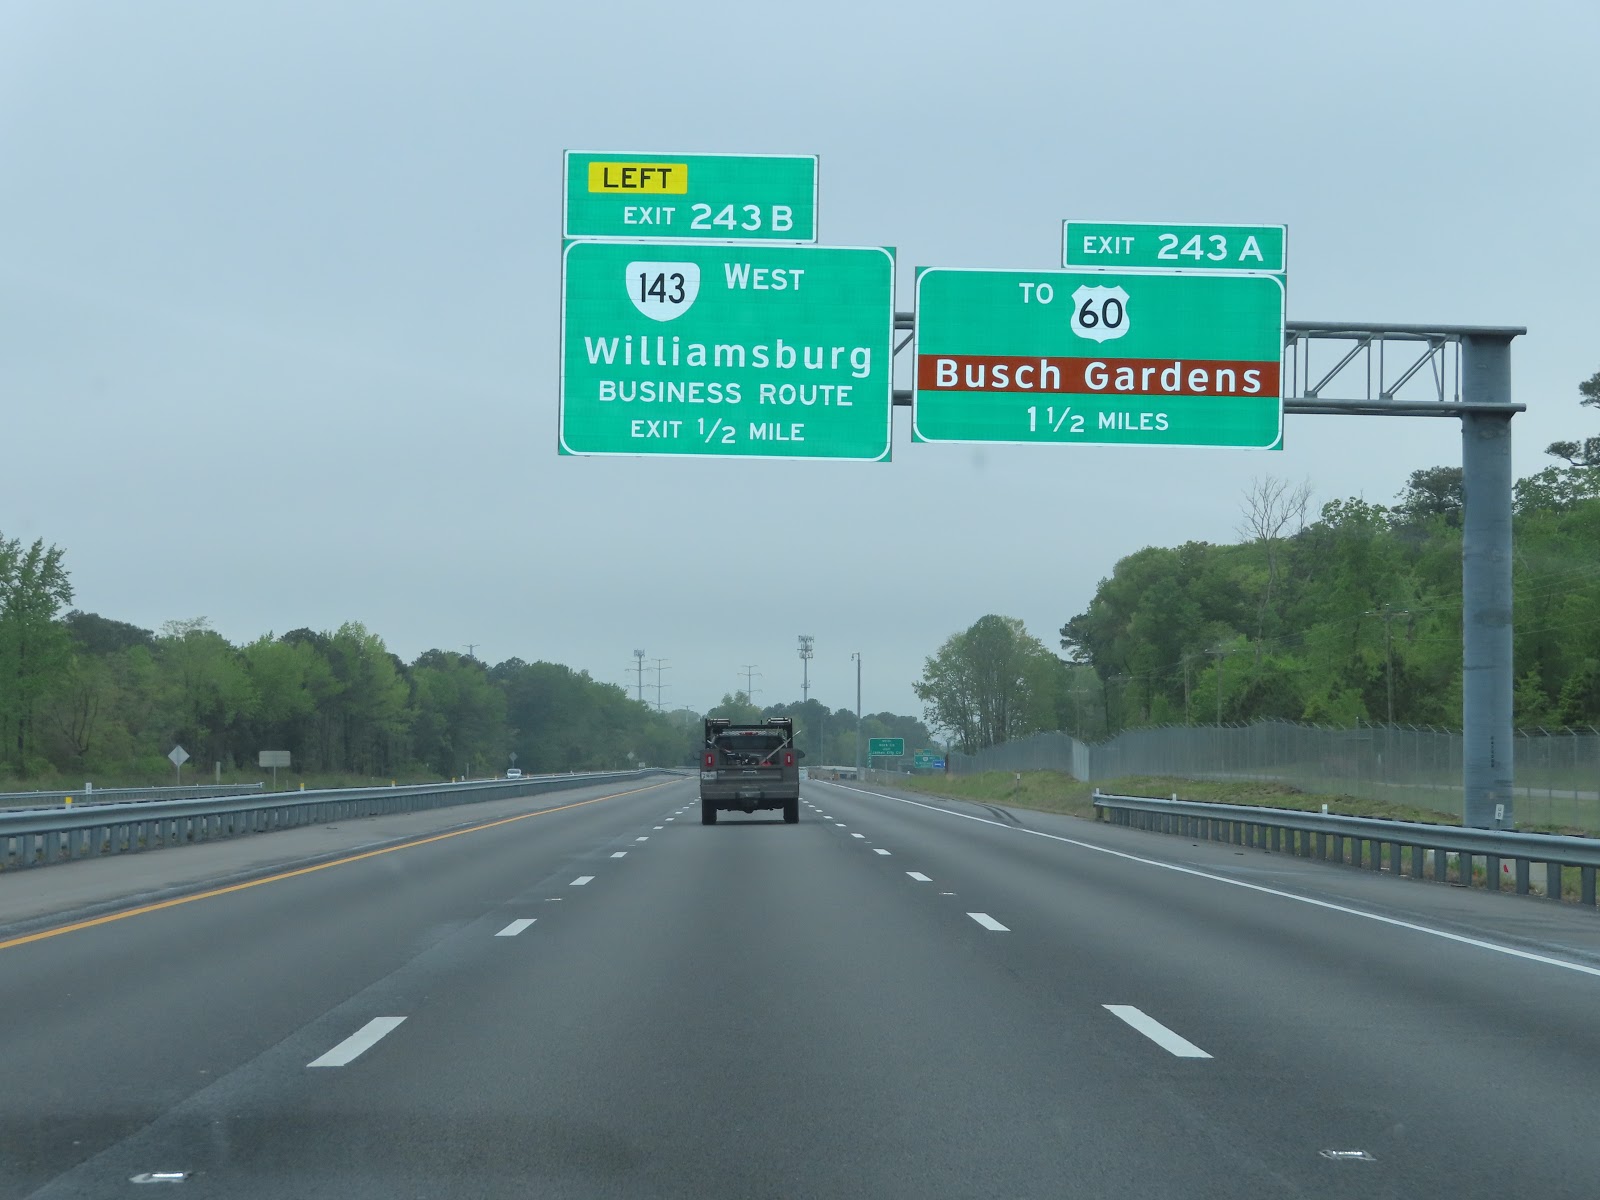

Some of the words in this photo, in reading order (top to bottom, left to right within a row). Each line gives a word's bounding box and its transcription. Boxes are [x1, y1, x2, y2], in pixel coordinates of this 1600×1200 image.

[603, 168, 672, 189] LEFT
[624, 207, 676, 225] EXIT
[691, 203, 762, 231] 243
[772, 206, 794, 231] B
[1084, 236, 1135, 254] EXIT
[1158, 234, 1228, 261] 243
[1239, 236, 1264, 261] A
[640, 273, 685, 303] 143
[725, 263, 805, 291] WEST
[1019, 283, 1054, 304] TO
[1079, 298, 1122, 328] 60
[585, 335, 872, 379] Williamsburg
[936, 359, 1060, 389] Busch
[1084, 362, 1261, 393] Gardens
[600, 381, 742, 404] BUSINESS
[760, 384, 853, 407] ROUTE
[631, 420, 683, 438] EXIT
[750, 423, 805, 441] MILE
[1099, 412, 1169, 431] MILES
